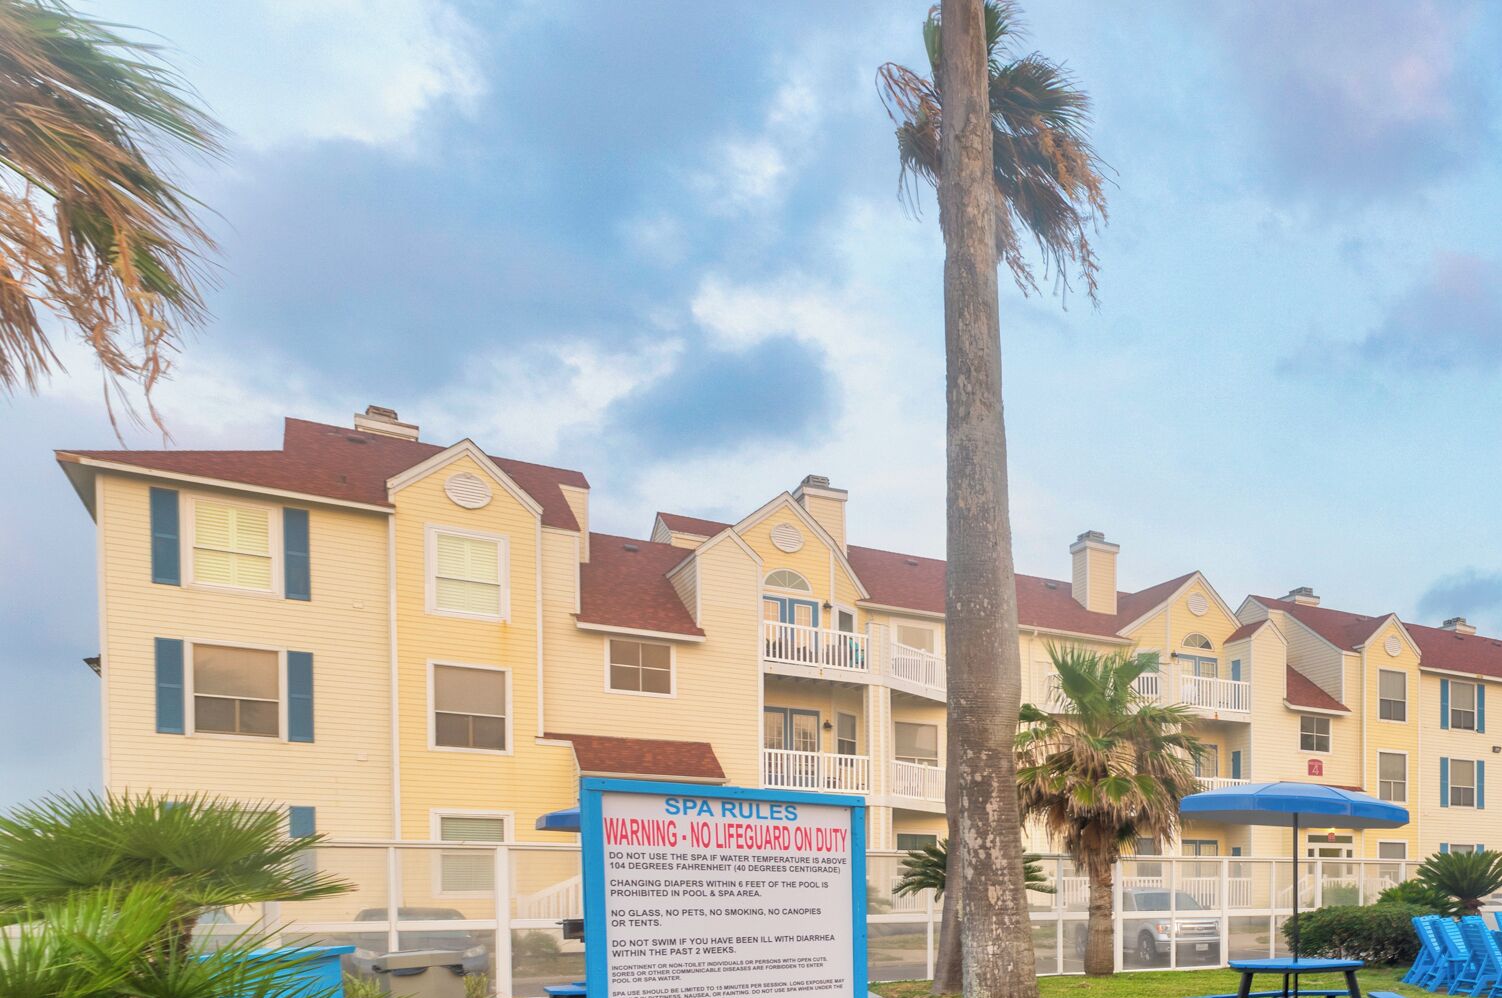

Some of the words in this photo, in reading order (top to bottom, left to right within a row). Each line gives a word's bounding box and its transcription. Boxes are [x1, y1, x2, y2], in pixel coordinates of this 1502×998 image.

[665, 797, 714, 817] SPA
[721, 801, 798, 821] RULES
[605, 818, 677, 847] WARNING
[691, 822, 711, 848] NO
[715, 823, 791, 851] LIFEGUARD
[794, 827, 812, 851] ON
[816, 828, 847, 852] DUTY
[609, 852, 624, 860] DO
[626, 852, 647, 860] NOT
[649, 853, 668, 861] USE
[670, 853, 688, 861] THE
[690, 854, 708, 862] SPA
[710, 854, 718, 862] IF
[751, 856, 810, 864] TEMPERATURE
[610, 862, 625, 870] 104
[629, 862, 674, 870] DEGREES
[677, 863, 732, 871] FAHRENHEIT
[789, 865, 840, 873] CENTIGRADE)
[664, 880, 704, 888] DIAPERS
[610, 889, 669, 897] PROHIBITED
[671, 889, 680, 897] IN
[683, 889, 708, 897] POOL
[710, 889, 716, 897] &
[718, 889, 735, 897] SPA
[611, 910, 626, 918] NO
[666, 909, 680, 917] NO
[612, 940, 627, 948] DO
[629, 939, 649, 947] NOT
[652, 939, 677, 947] SWIM
[679, 938, 687, 946] IF
[711, 937, 734, 945] HAVE
[736, 936, 758, 944] BEEN
[775, 935, 794, 943] WITH
[796, 934, 835, 942] DIARRHEA
[612, 949, 647, 958] WITHIN
[649, 948, 668, 956] THE
[670, 947, 694, 956] PAST
[696, 947, 701, 955] 2
[672, 967, 721, 975] COMMUNICABLE
